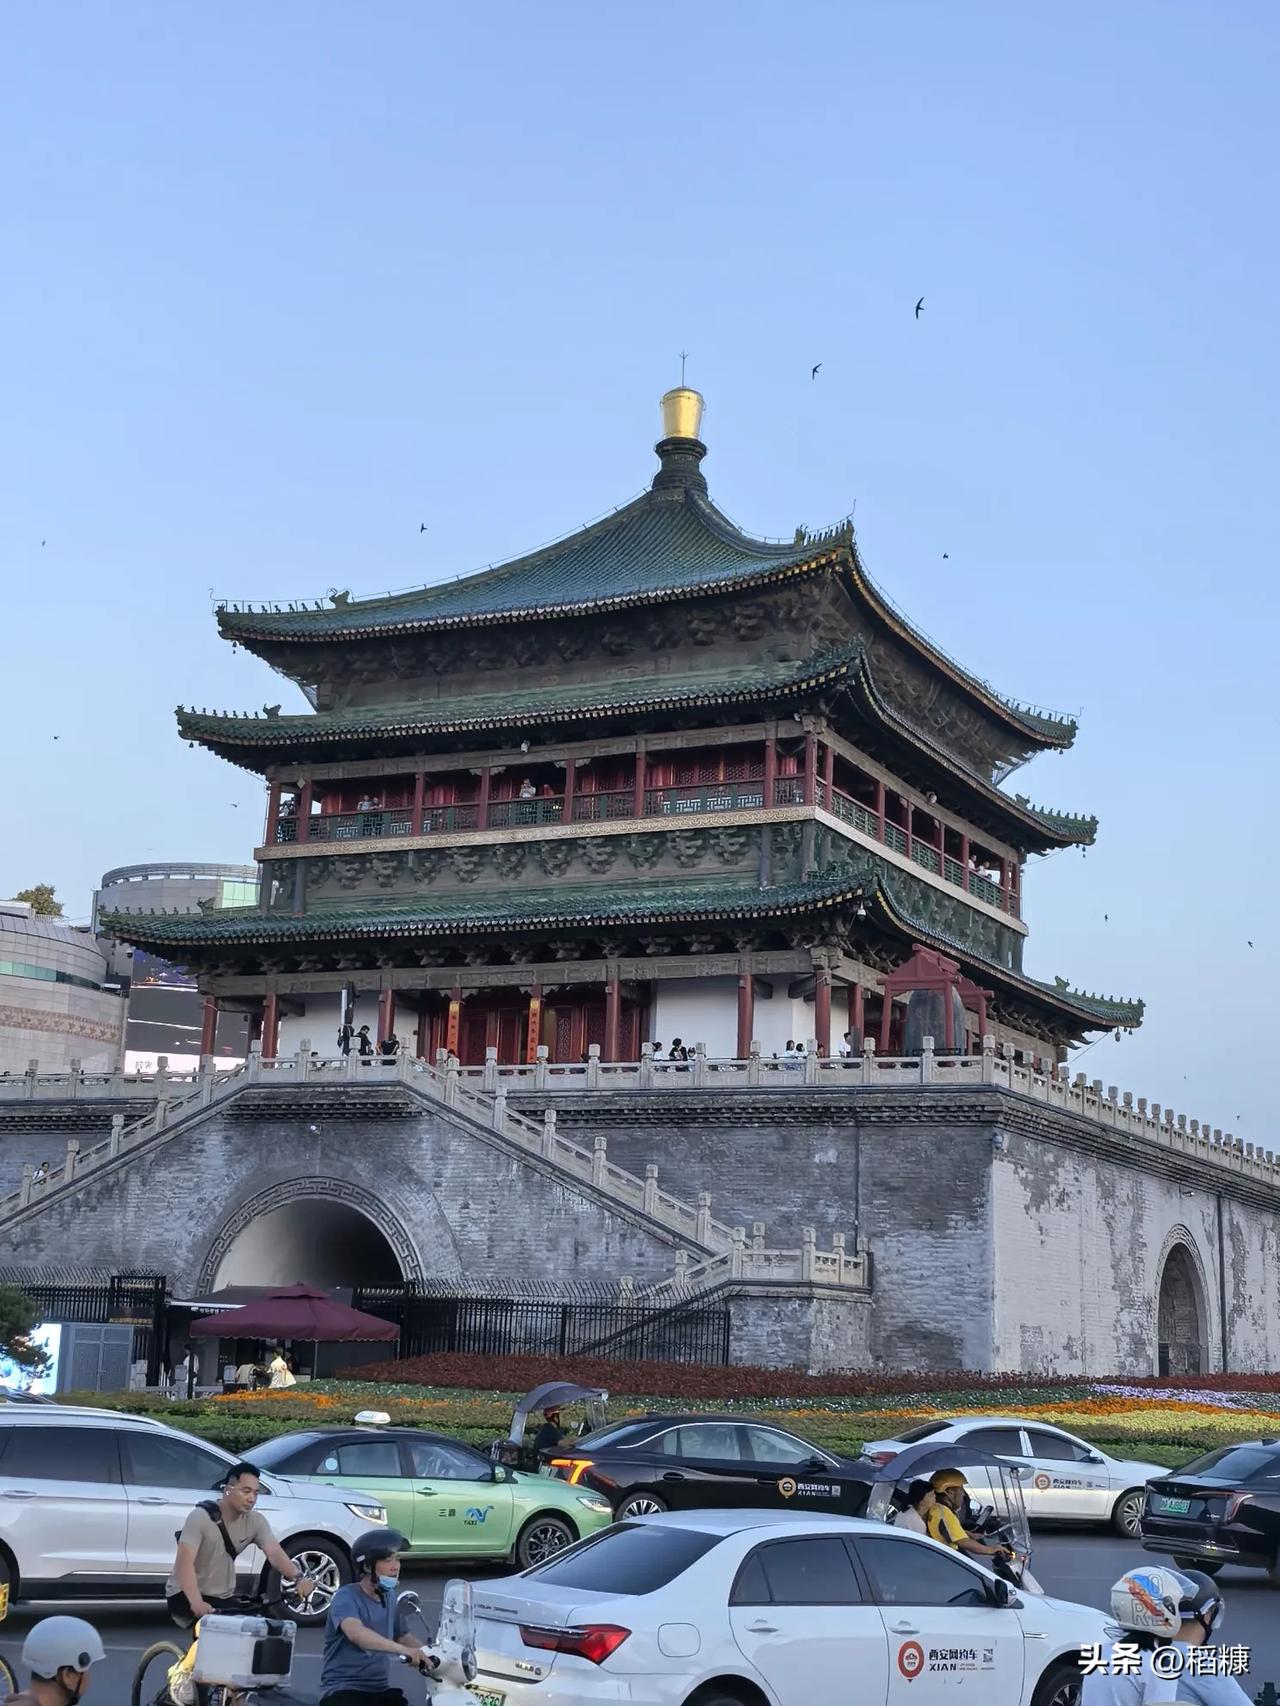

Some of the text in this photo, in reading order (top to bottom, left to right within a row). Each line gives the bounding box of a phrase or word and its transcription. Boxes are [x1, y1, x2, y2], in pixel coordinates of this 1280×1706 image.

[929, 1649, 978, 1660] 西安网约车
[929, 1663, 957, 1671] XIAN
